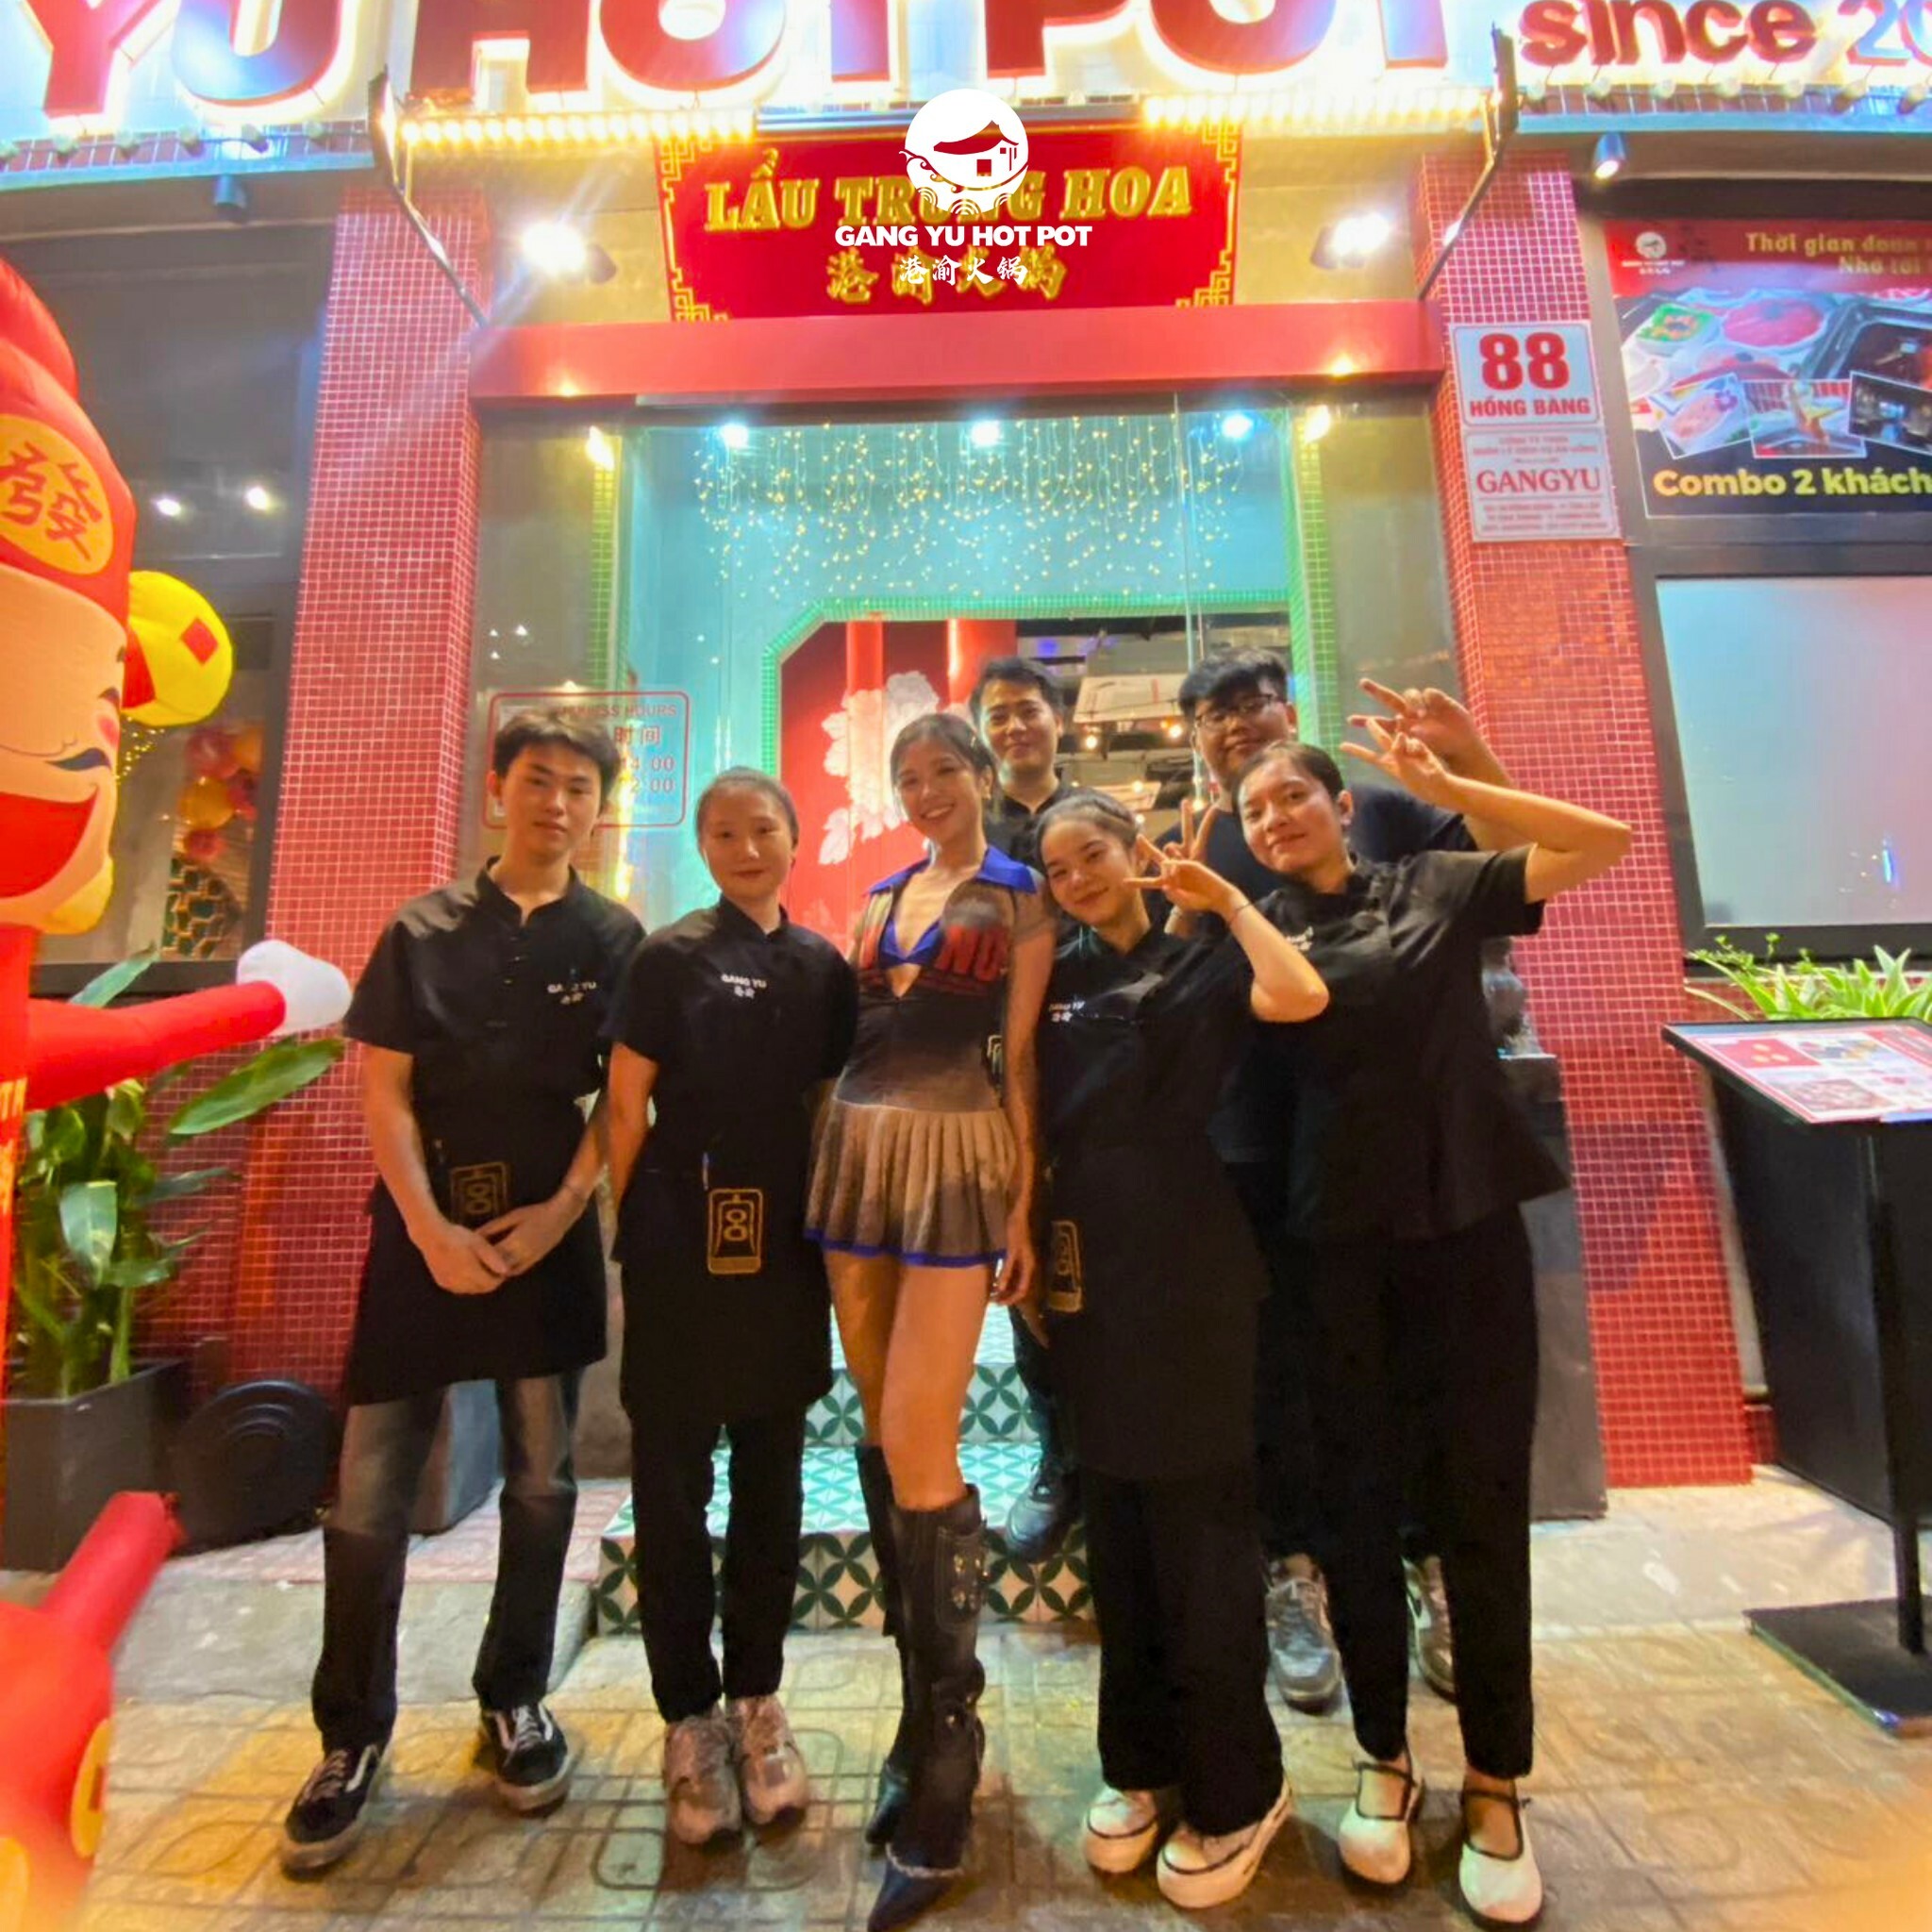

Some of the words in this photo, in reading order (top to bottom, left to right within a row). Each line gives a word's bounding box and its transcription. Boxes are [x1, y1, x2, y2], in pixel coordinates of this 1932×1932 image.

[1518, 0, 1817, 65] since
[834, 172, 1046, 227] TRG
[1058, 166, 1193, 221] HOA
[1479, 331, 1571, 391] 88
[1475, 467, 1602, 494] GANGYU
[1653, 467, 1788, 496] Combo
[1791, 469, 1818, 496] 2
[1820, 466, 1932, 496] khách
